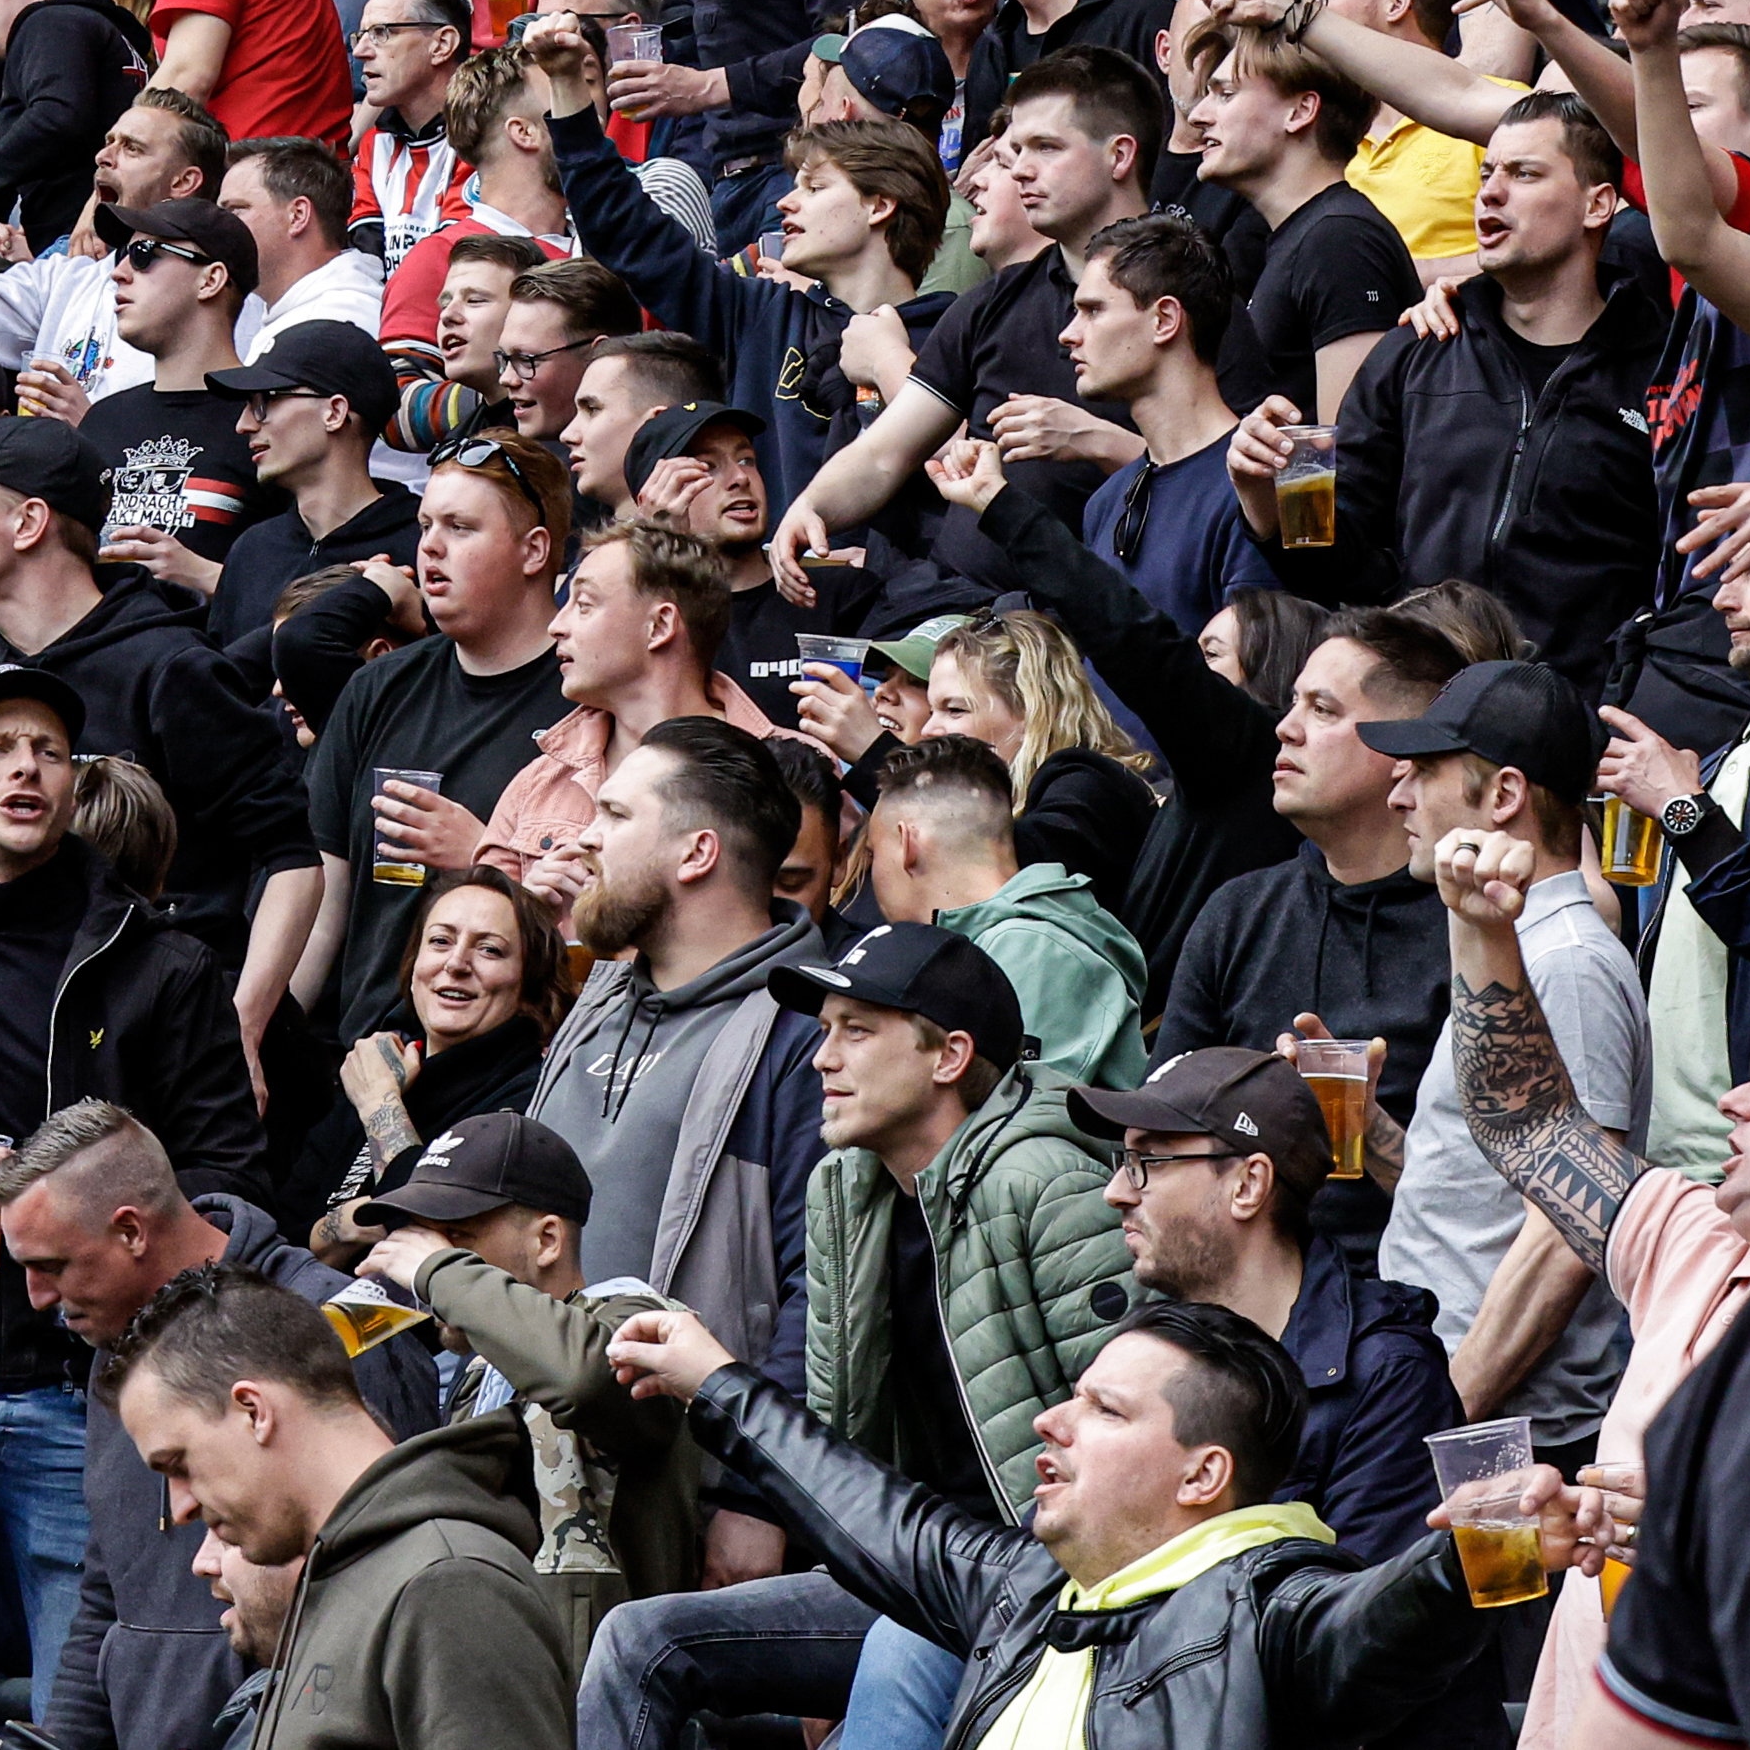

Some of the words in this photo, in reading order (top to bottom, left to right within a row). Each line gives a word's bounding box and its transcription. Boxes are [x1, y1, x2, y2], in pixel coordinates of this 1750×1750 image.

[110, 493, 189, 510] ENDRACHT
[107, 509, 139, 524] AKT
[139, 510, 195, 527] MACHT
[750, 658, 802, 678] 040
